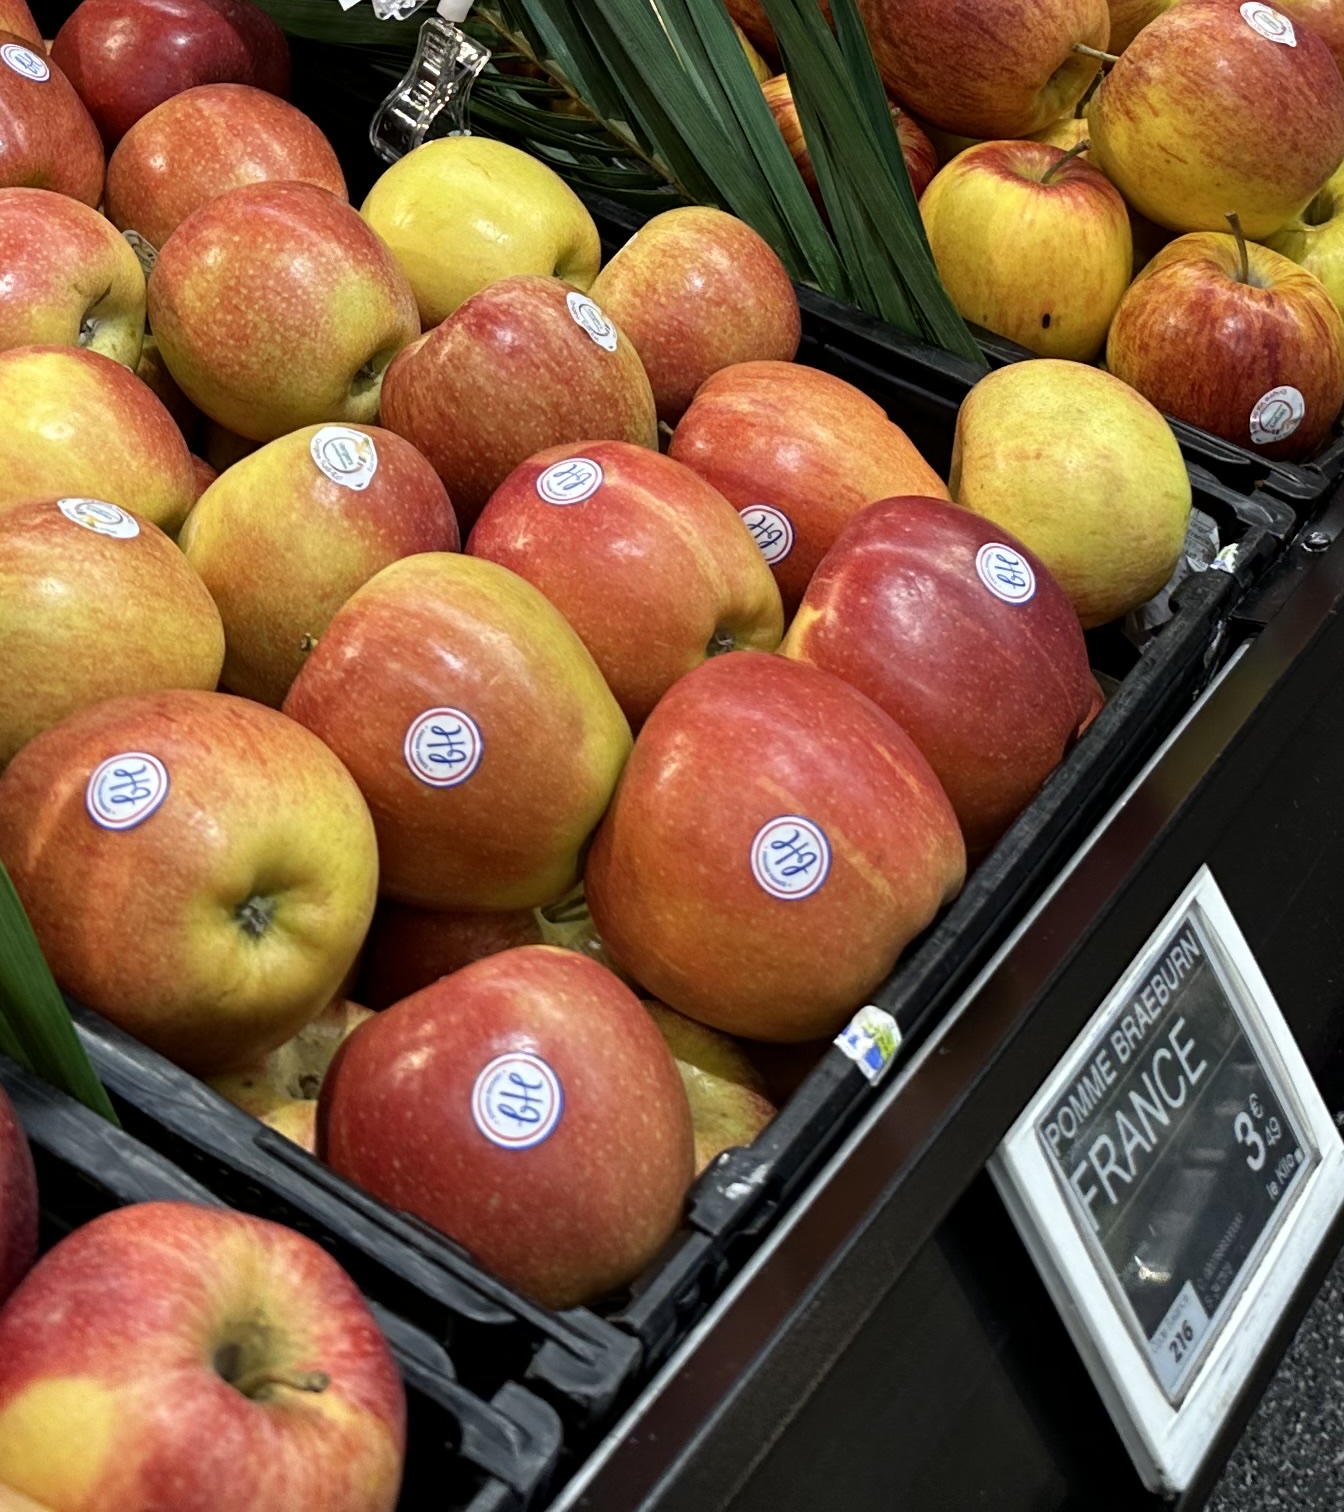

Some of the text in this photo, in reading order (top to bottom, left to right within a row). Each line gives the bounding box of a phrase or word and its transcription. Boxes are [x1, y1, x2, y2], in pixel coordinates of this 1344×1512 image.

[1044, 928, 1201, 1158] POMME BRAEBURN
[1069, 1016, 1208, 1232] FRANCE
[1168, 1319, 1195, 1364] 216
